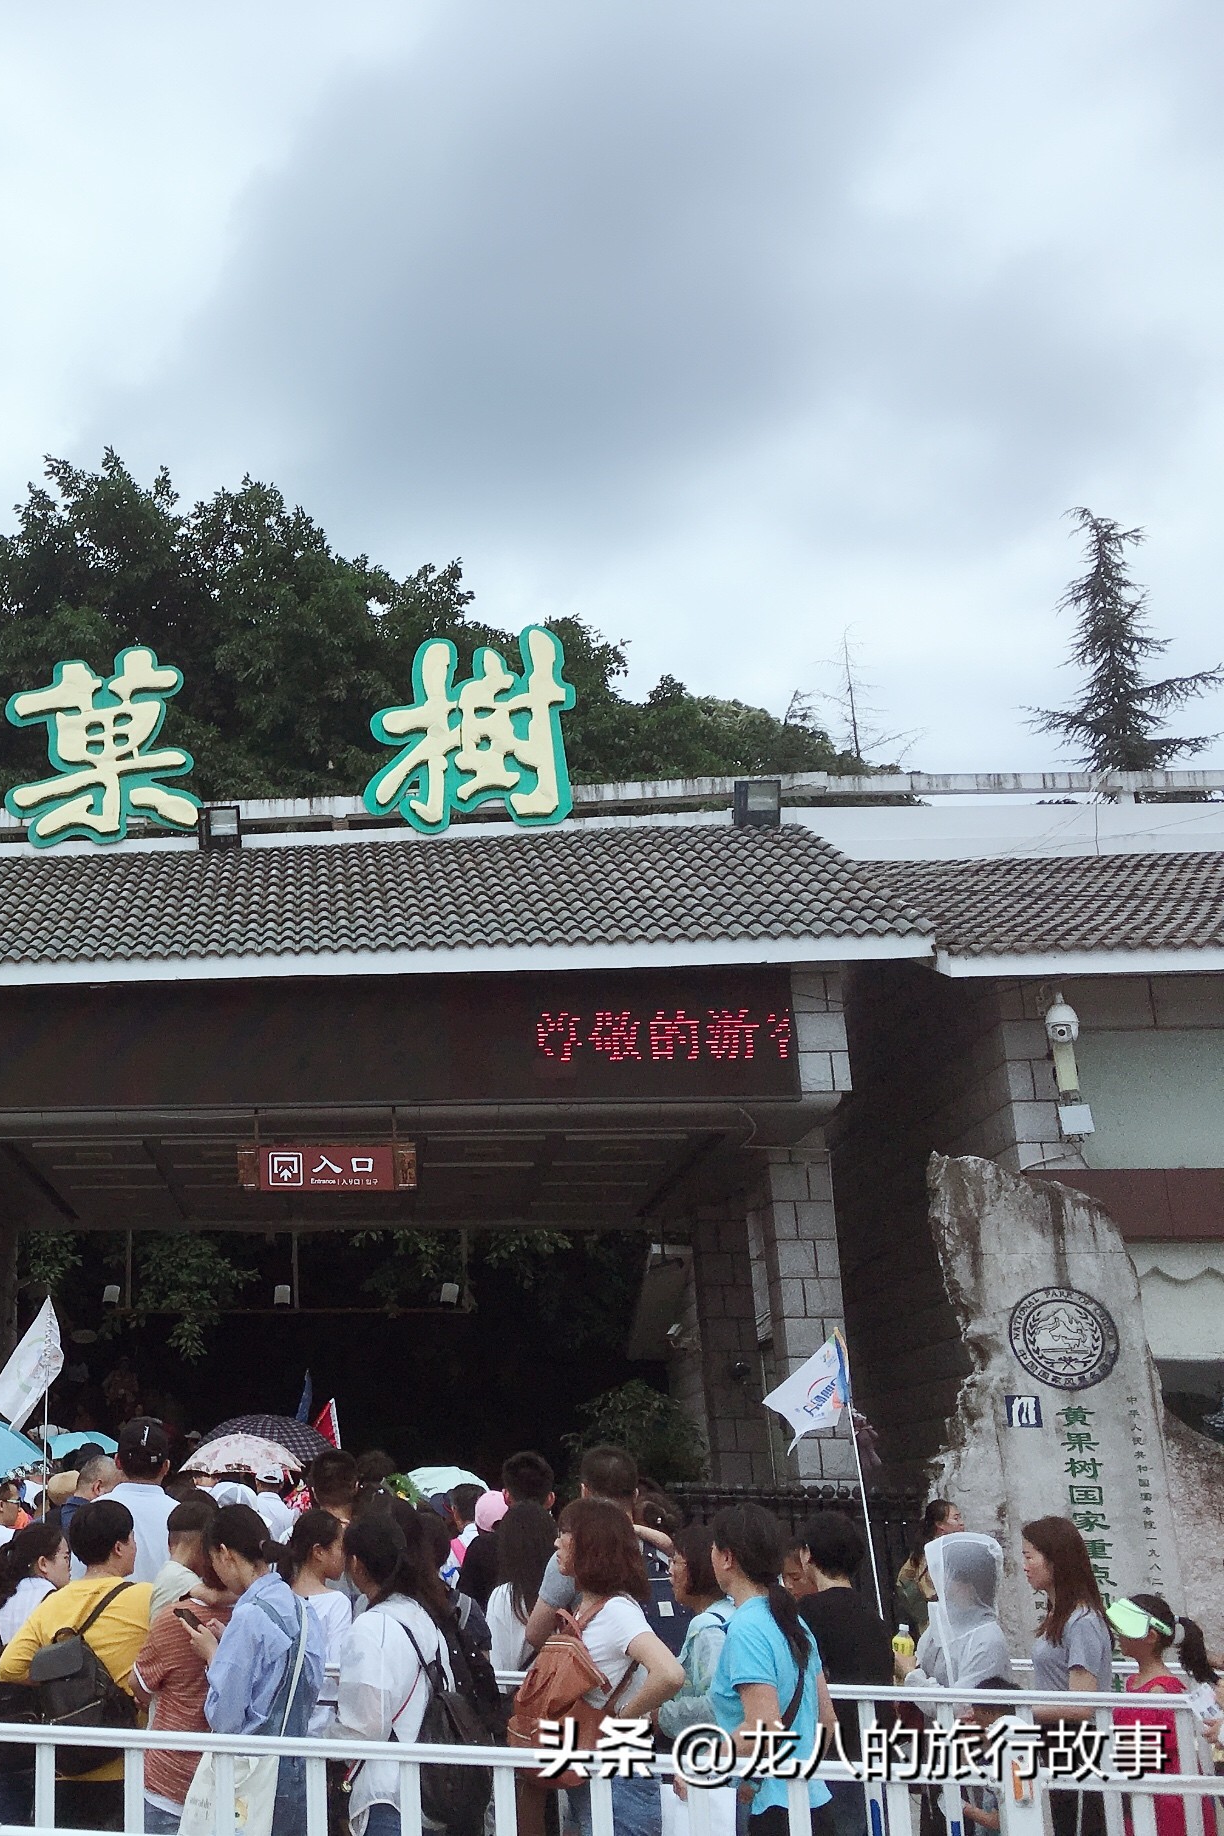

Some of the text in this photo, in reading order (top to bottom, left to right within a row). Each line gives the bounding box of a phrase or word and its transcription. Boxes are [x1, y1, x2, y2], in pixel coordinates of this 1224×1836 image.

[312, 1154, 374, 1173] 入口
[1013, 1296, 1040, 1340] NATIONAL
[1044, 1291, 1074, 1299] PARK
[1079, 1296, 1092, 1306] OF
